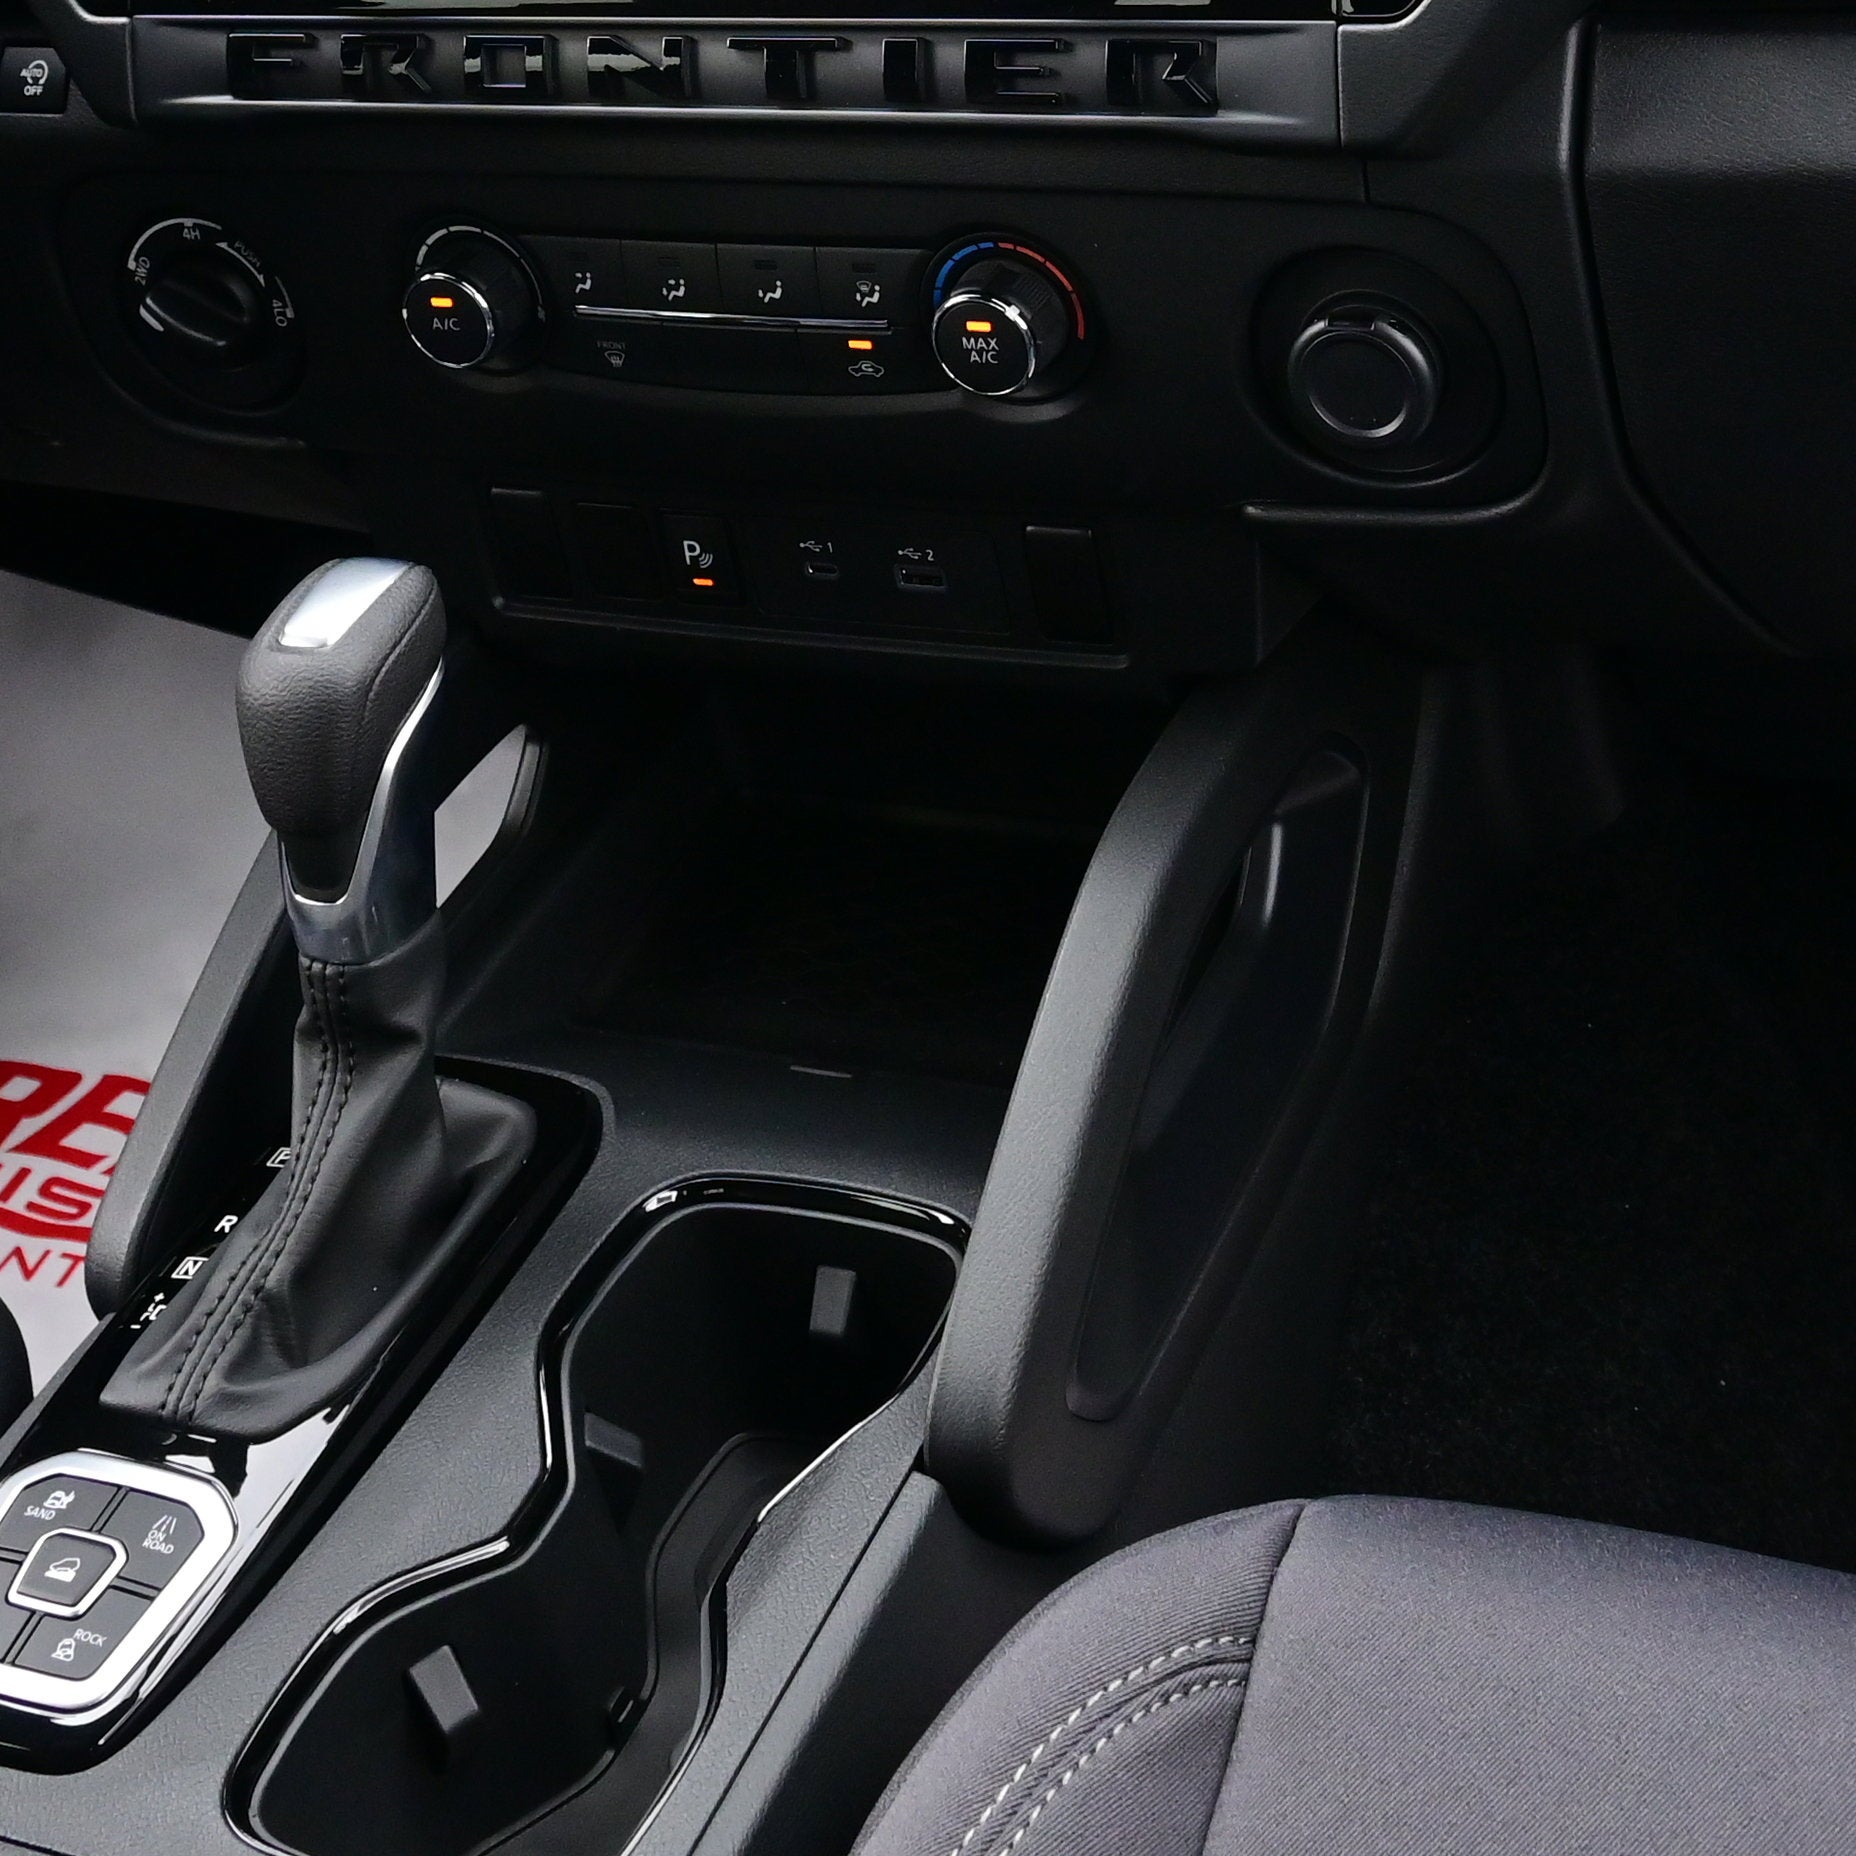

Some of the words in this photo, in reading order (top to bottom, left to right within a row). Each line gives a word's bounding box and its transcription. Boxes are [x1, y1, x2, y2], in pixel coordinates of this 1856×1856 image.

[20, 68, 43, 77] AUTO
[227, 31, 1219, 112] FRONTIER
[24, 85, 43, 96] OFF
[183, 228, 200, 240] 4H
[134, 256, 150, 286] 2WD
[272, 299, 288, 327] 4LO
[961, 337, 1000, 351] MAX
[214, 1215, 238, 1233] R
[24, 1505, 56, 1520] SAND
[147, 1530, 166, 1541] ON
[142, 1538, 174, 1555] ROAD
[74, 1628, 107, 1647] ROCK
